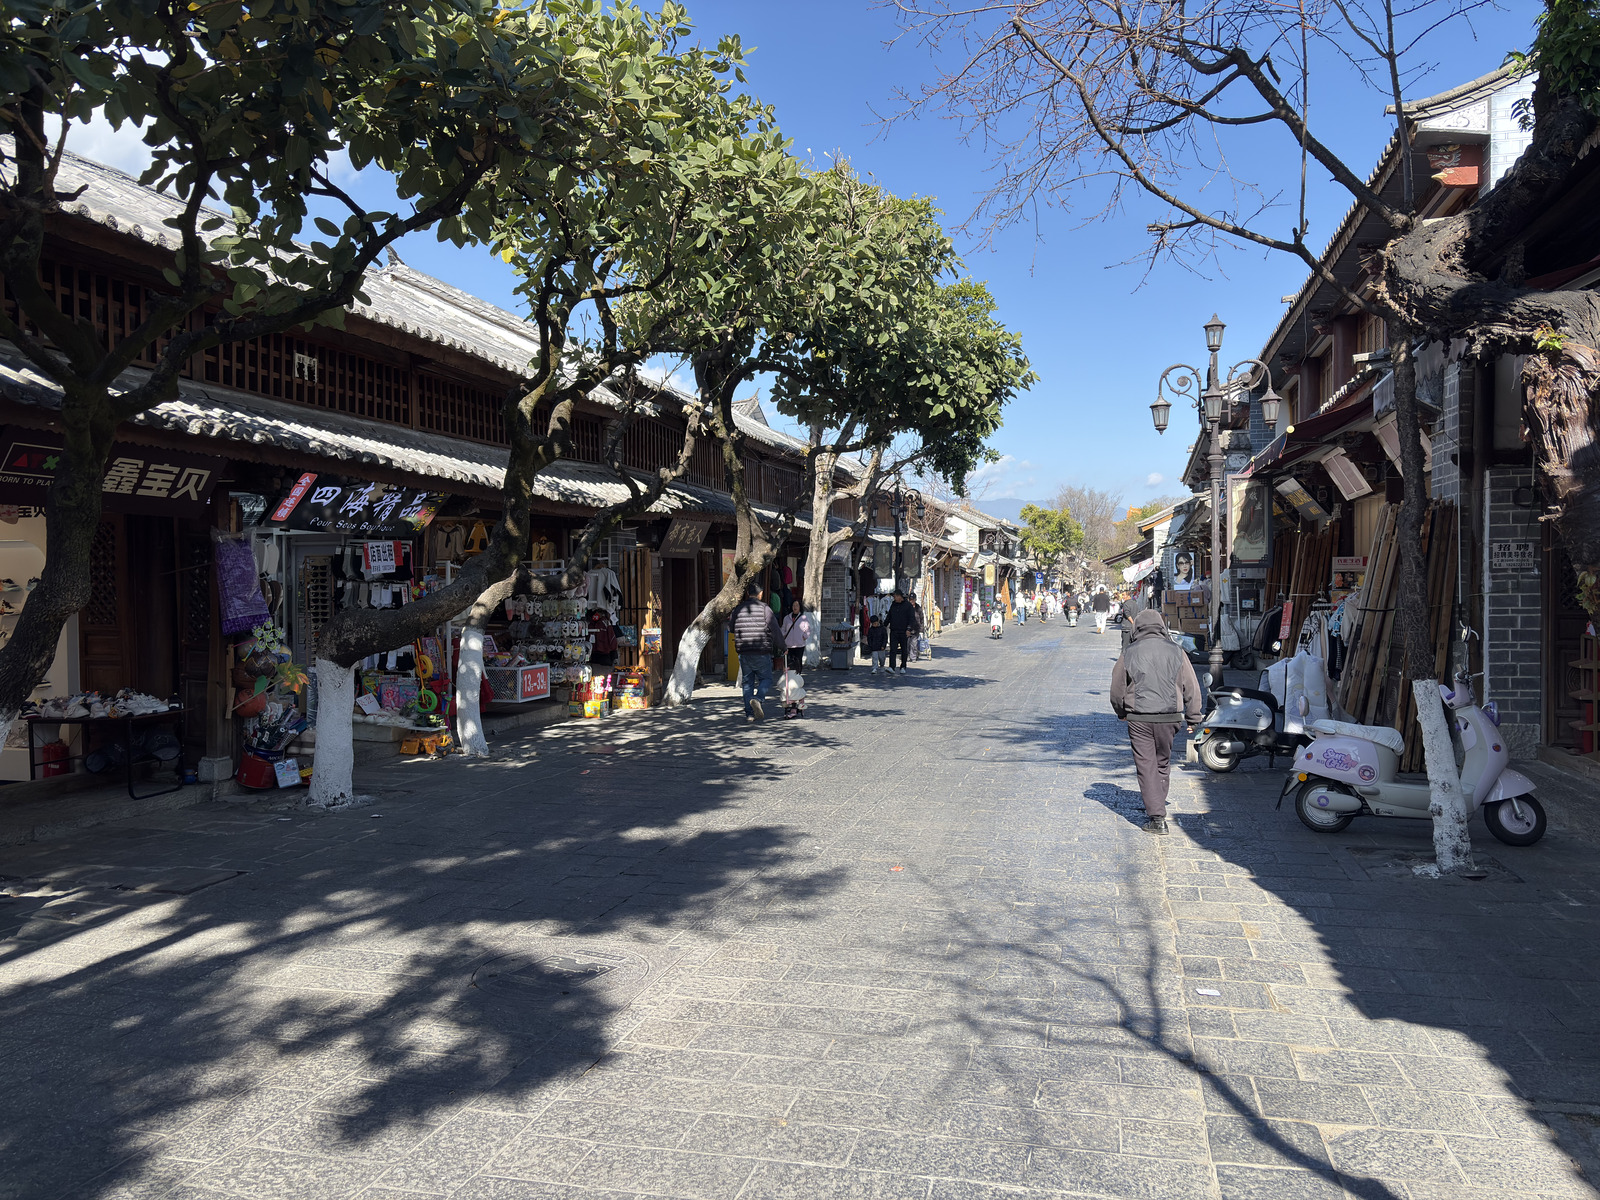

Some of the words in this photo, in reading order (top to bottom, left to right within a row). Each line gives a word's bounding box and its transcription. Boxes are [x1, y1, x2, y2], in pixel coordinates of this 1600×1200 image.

[23, 477, 34, 485] TO
[101, 457, 211, 501] 鑫宝贝
[277, 475, 311, 518] 全国连锁
[310, 482, 428, 521] 四海精品
[370, 544, 394, 563] 店面出租
